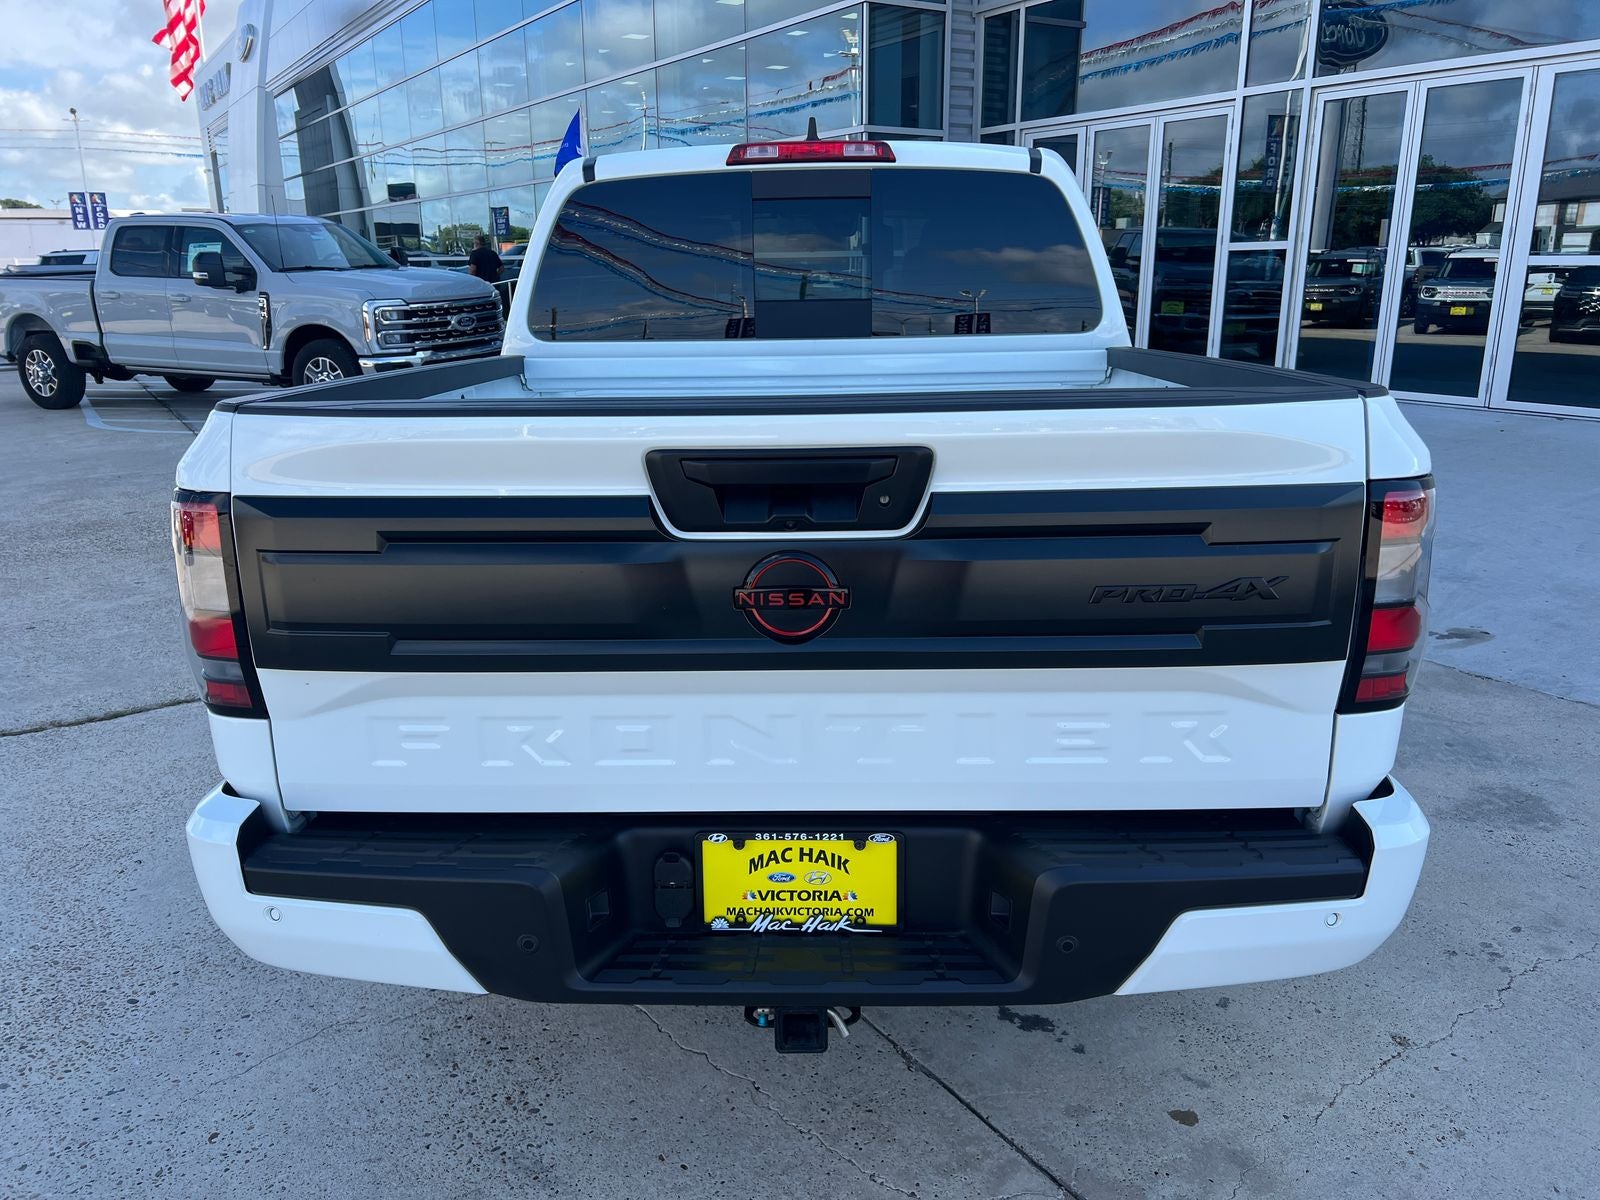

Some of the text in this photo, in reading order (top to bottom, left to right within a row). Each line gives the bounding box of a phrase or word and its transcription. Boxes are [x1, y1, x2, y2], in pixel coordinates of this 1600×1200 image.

[75, 206, 87, 229] NEW
[95, 206, 106, 229] FORD
[738, 592, 845, 606] NISSAN
[1089, 576, 1290, 604] PRO-4X
[366, 713, 1232, 766] FRONTIER
[748, 847, 851, 876] MAC HAIK
[757, 890, 843, 901] VICTORIA
[726, 907, 874, 917] MACHAIKVICTORIACOM
[748, 914, 860, 932] Mac Haik
